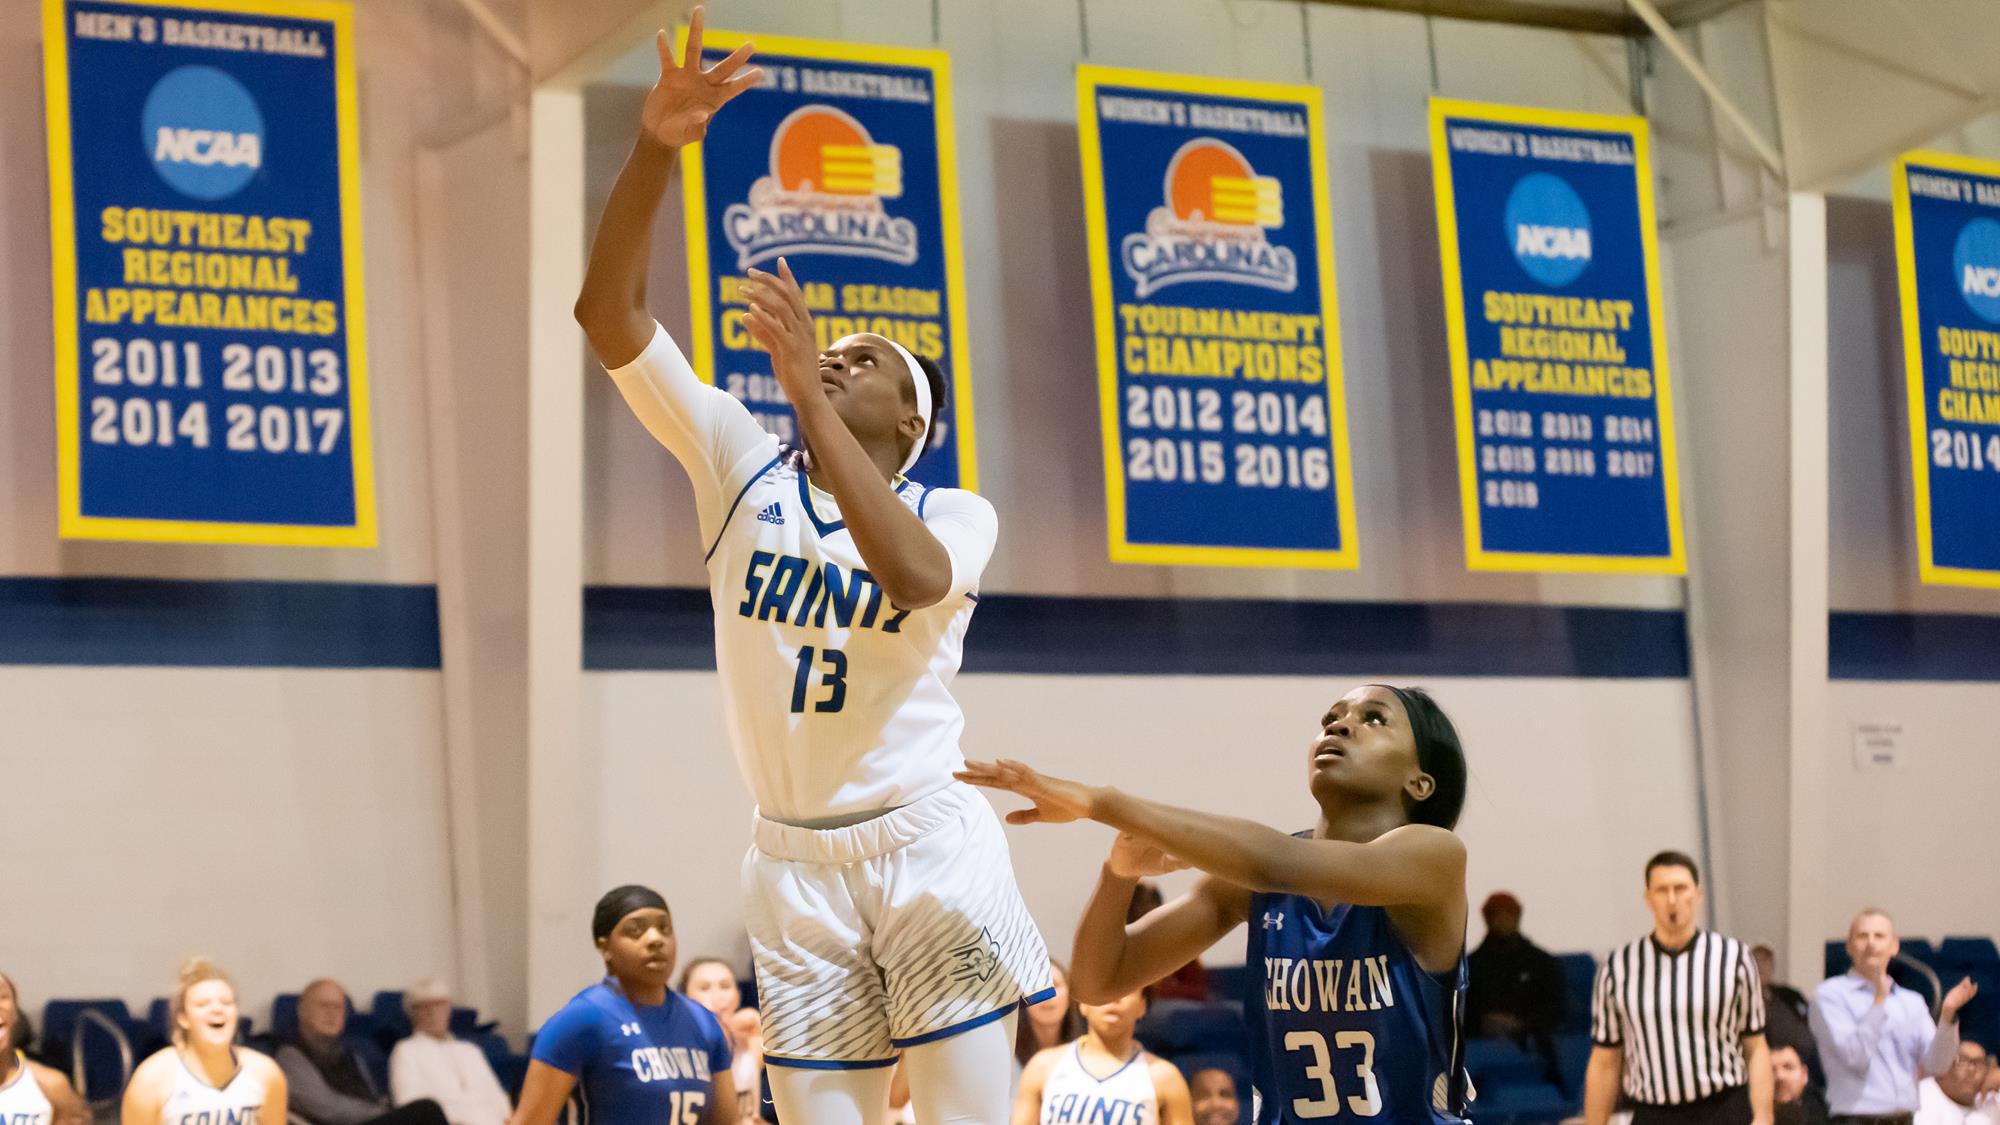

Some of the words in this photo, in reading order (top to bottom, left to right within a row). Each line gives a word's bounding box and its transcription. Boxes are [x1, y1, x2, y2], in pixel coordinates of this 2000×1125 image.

[75, 11, 157, 43] MEN'S
[162, 18, 326, 58] BASKETBALL
[801, 68, 930, 103] BASKETBALL
[155, 127, 261, 167] NCAA
[102, 207, 311, 254] SOUTHEAST
[729, 210, 912, 250] CAROLINAS
[1516, 224, 1592, 260] NCAA
[123, 249, 298, 292] REGIONAL
[1127, 239, 1294, 280] CAROLINAS
[86, 289, 337, 336] APPEARANCES
[720, 276, 834, 310] REAR
[842, 285, 940, 315] SEASON
[1484, 290, 1633, 331] SOUTHEAST
[1120, 304, 1320, 343] TOURNAMENT
[1124, 336, 1323, 384] CHAMPIONS
[1501, 326, 1626, 363] REGIONAL
[92, 338, 203, 389] 2011
[222, 344, 341, 396] 2013
[1473, 360, 1652, 399] APPEARANCES
[91, 397, 210, 449] 2014
[226, 404, 343, 455] 2017
[1126, 385, 1223, 433] 2012
[1232, 390, 1326, 437] 2014
[1479, 409, 1533, 438] 2012
[1542, 412, 1593, 442] 2013
[1604, 415, 1653, 443] 2014
[1128, 438, 1225, 484] 2015
[1236, 444, 1330, 489] 2016
[1607, 449, 1655, 478] 2017
[1931, 428, 2000, 473] 2014
[757, 511, 785, 525] adidas
[790, 645, 848, 713] 13
[631, 1046, 712, 1083] CHOWAN
[1284, 1031, 1383, 1119] 33
[669, 1090, 706, 1125] 15
[1047, 1093, 1147, 1125] SAINTS
